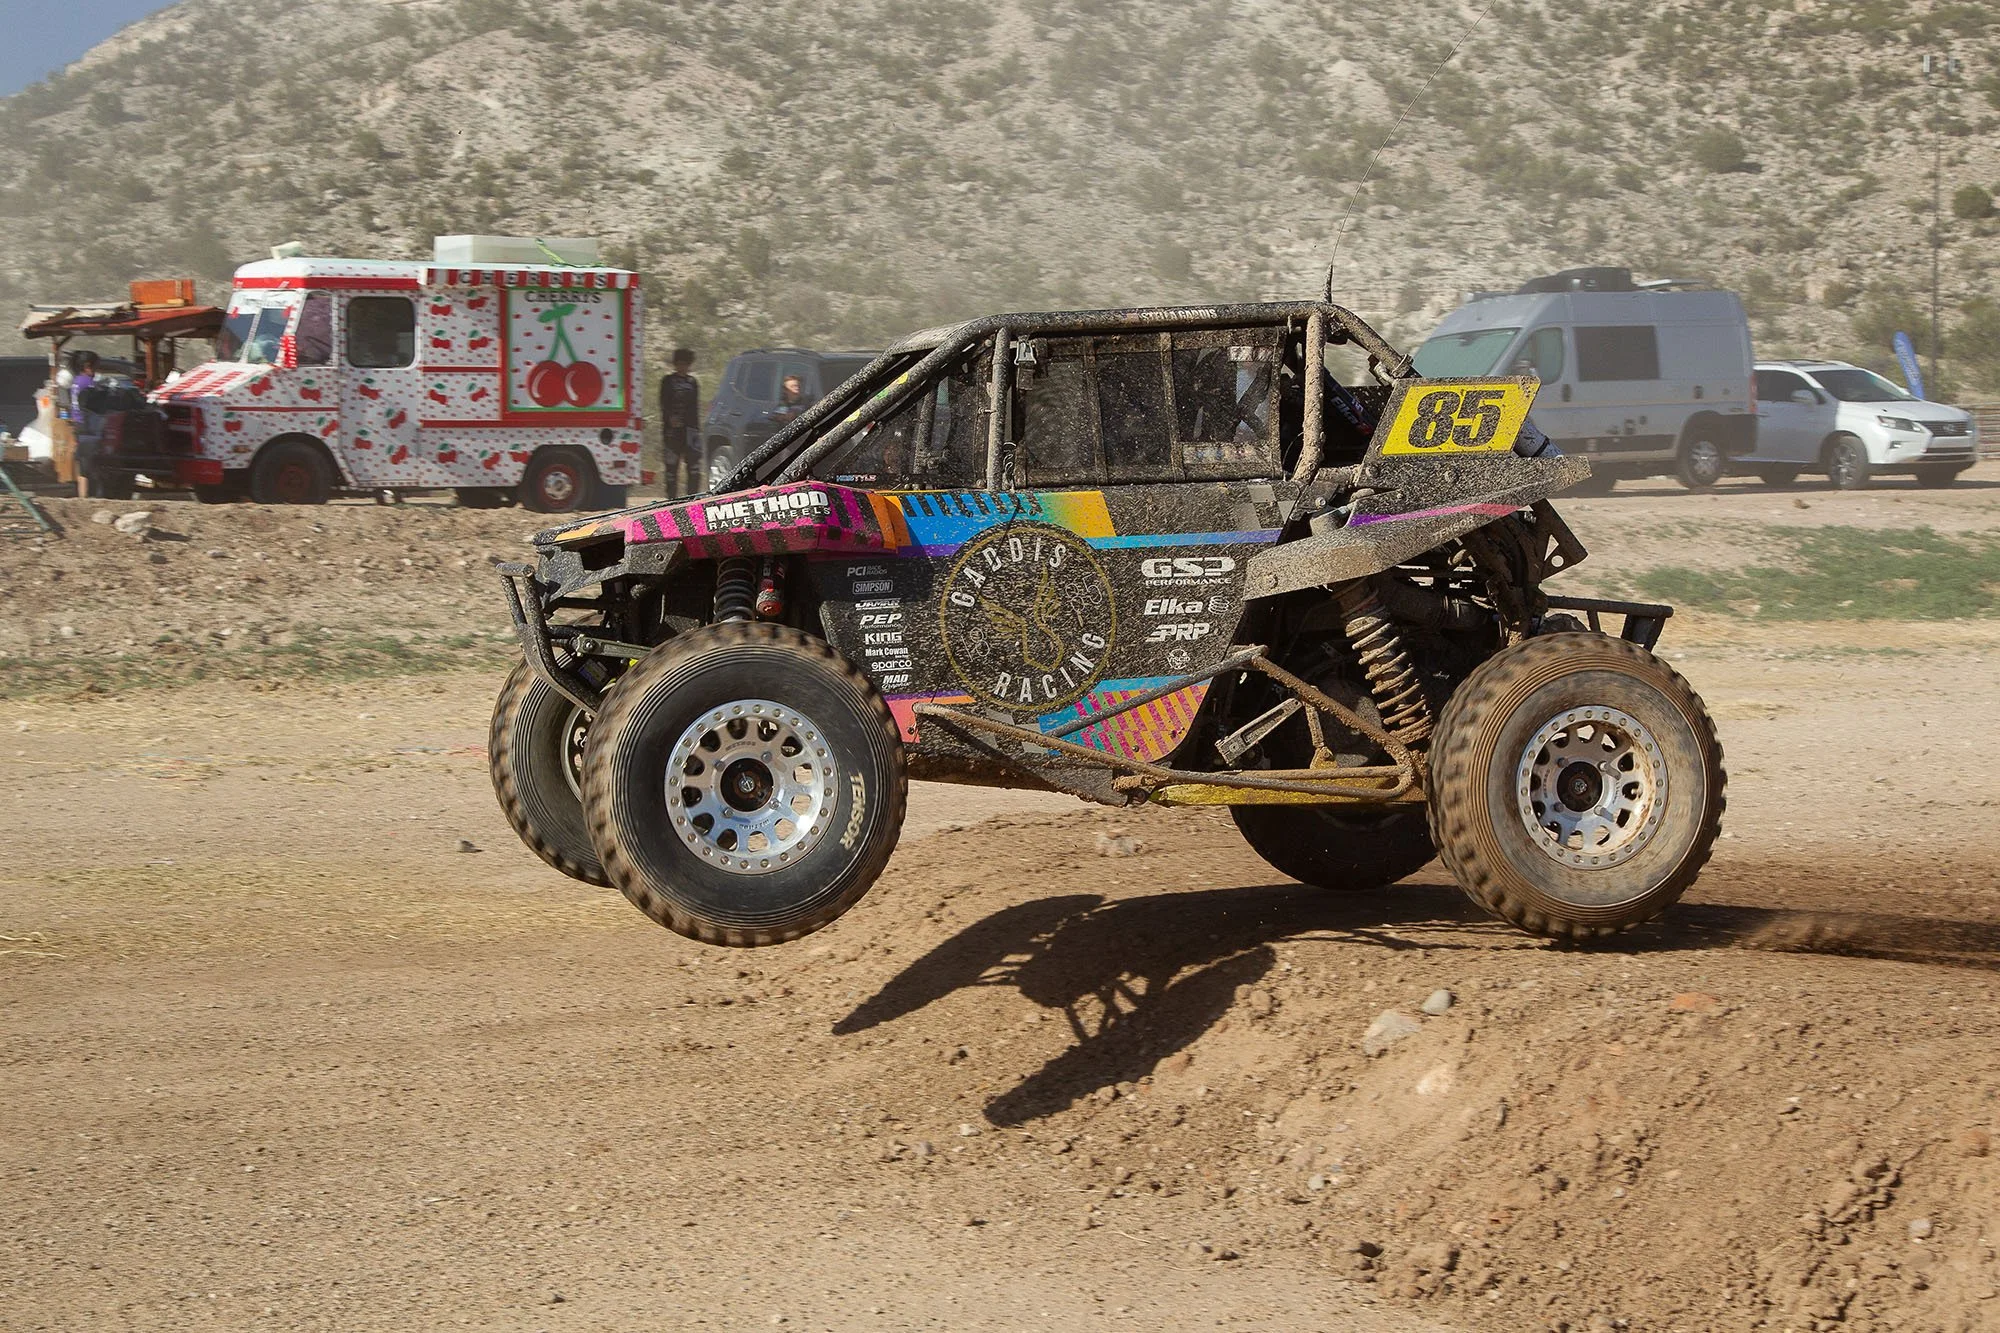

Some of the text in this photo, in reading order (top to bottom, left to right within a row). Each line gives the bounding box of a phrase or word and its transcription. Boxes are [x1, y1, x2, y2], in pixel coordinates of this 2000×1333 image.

[1408, 390, 1505, 448] 85
[705, 491, 829, 522] METHOD
[708, 507, 831, 530] RACE WHEELS
[846, 566, 867, 577] PCI
[951, 537, 1067, 607] GADDIS
[855, 582, 890, 593] SIMPSON
[1145, 578, 1232, 587] PERFORMANCE
[1065, 573, 1103, 612] 85
[1144, 599, 1203, 615] Elka
[860, 613, 902, 625] PEP
[864, 632, 902, 645] KING
[1145, 622, 1210, 642] PRP
[865, 647, 884, 657] Mark
[884, 647, 908, 656] Cowan
[871, 660, 912, 672] sparco
[994, 633, 1105, 702] RACING
[883, 674, 908, 684] MAD
[839, 768, 866, 850] TENSOR
